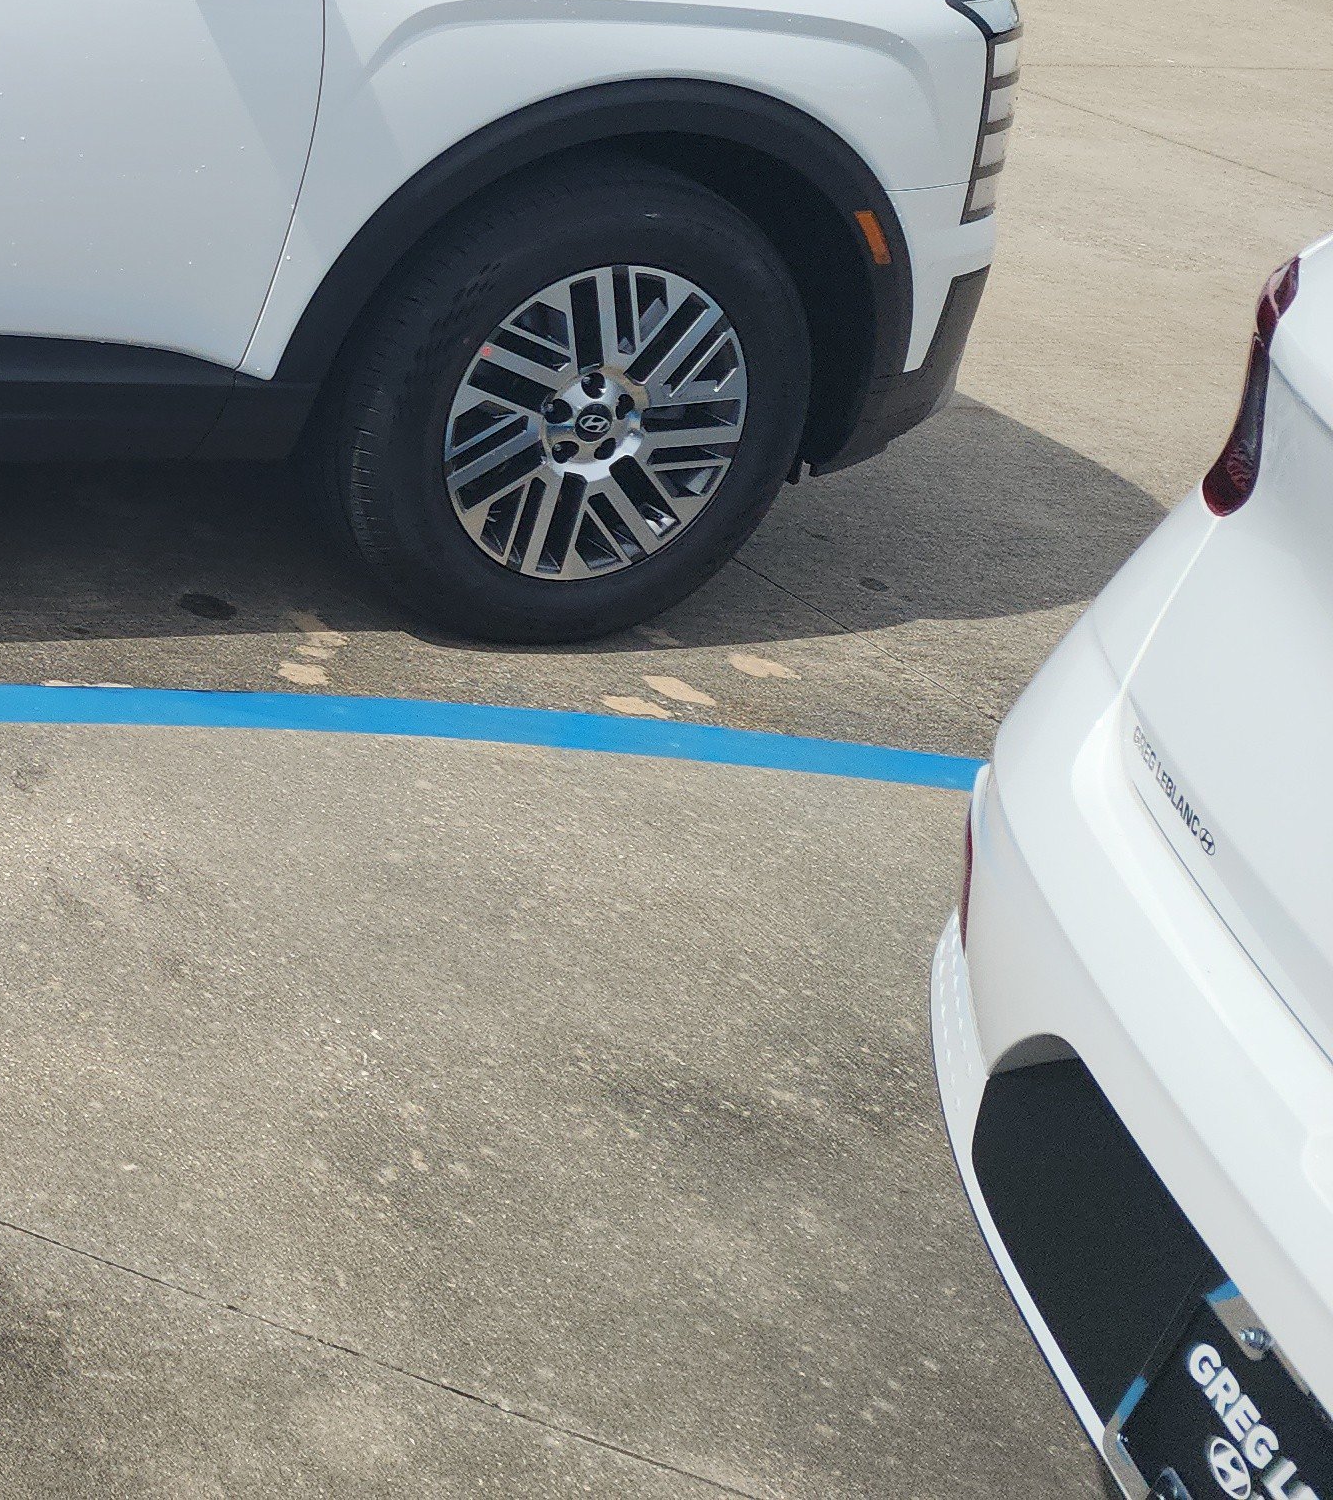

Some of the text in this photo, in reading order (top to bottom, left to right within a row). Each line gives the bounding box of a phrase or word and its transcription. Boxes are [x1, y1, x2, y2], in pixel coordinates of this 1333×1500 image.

[1133, 725, 1200, 836] GREG LEBLANC
[1188, 1342, 1280, 1469] GREG
